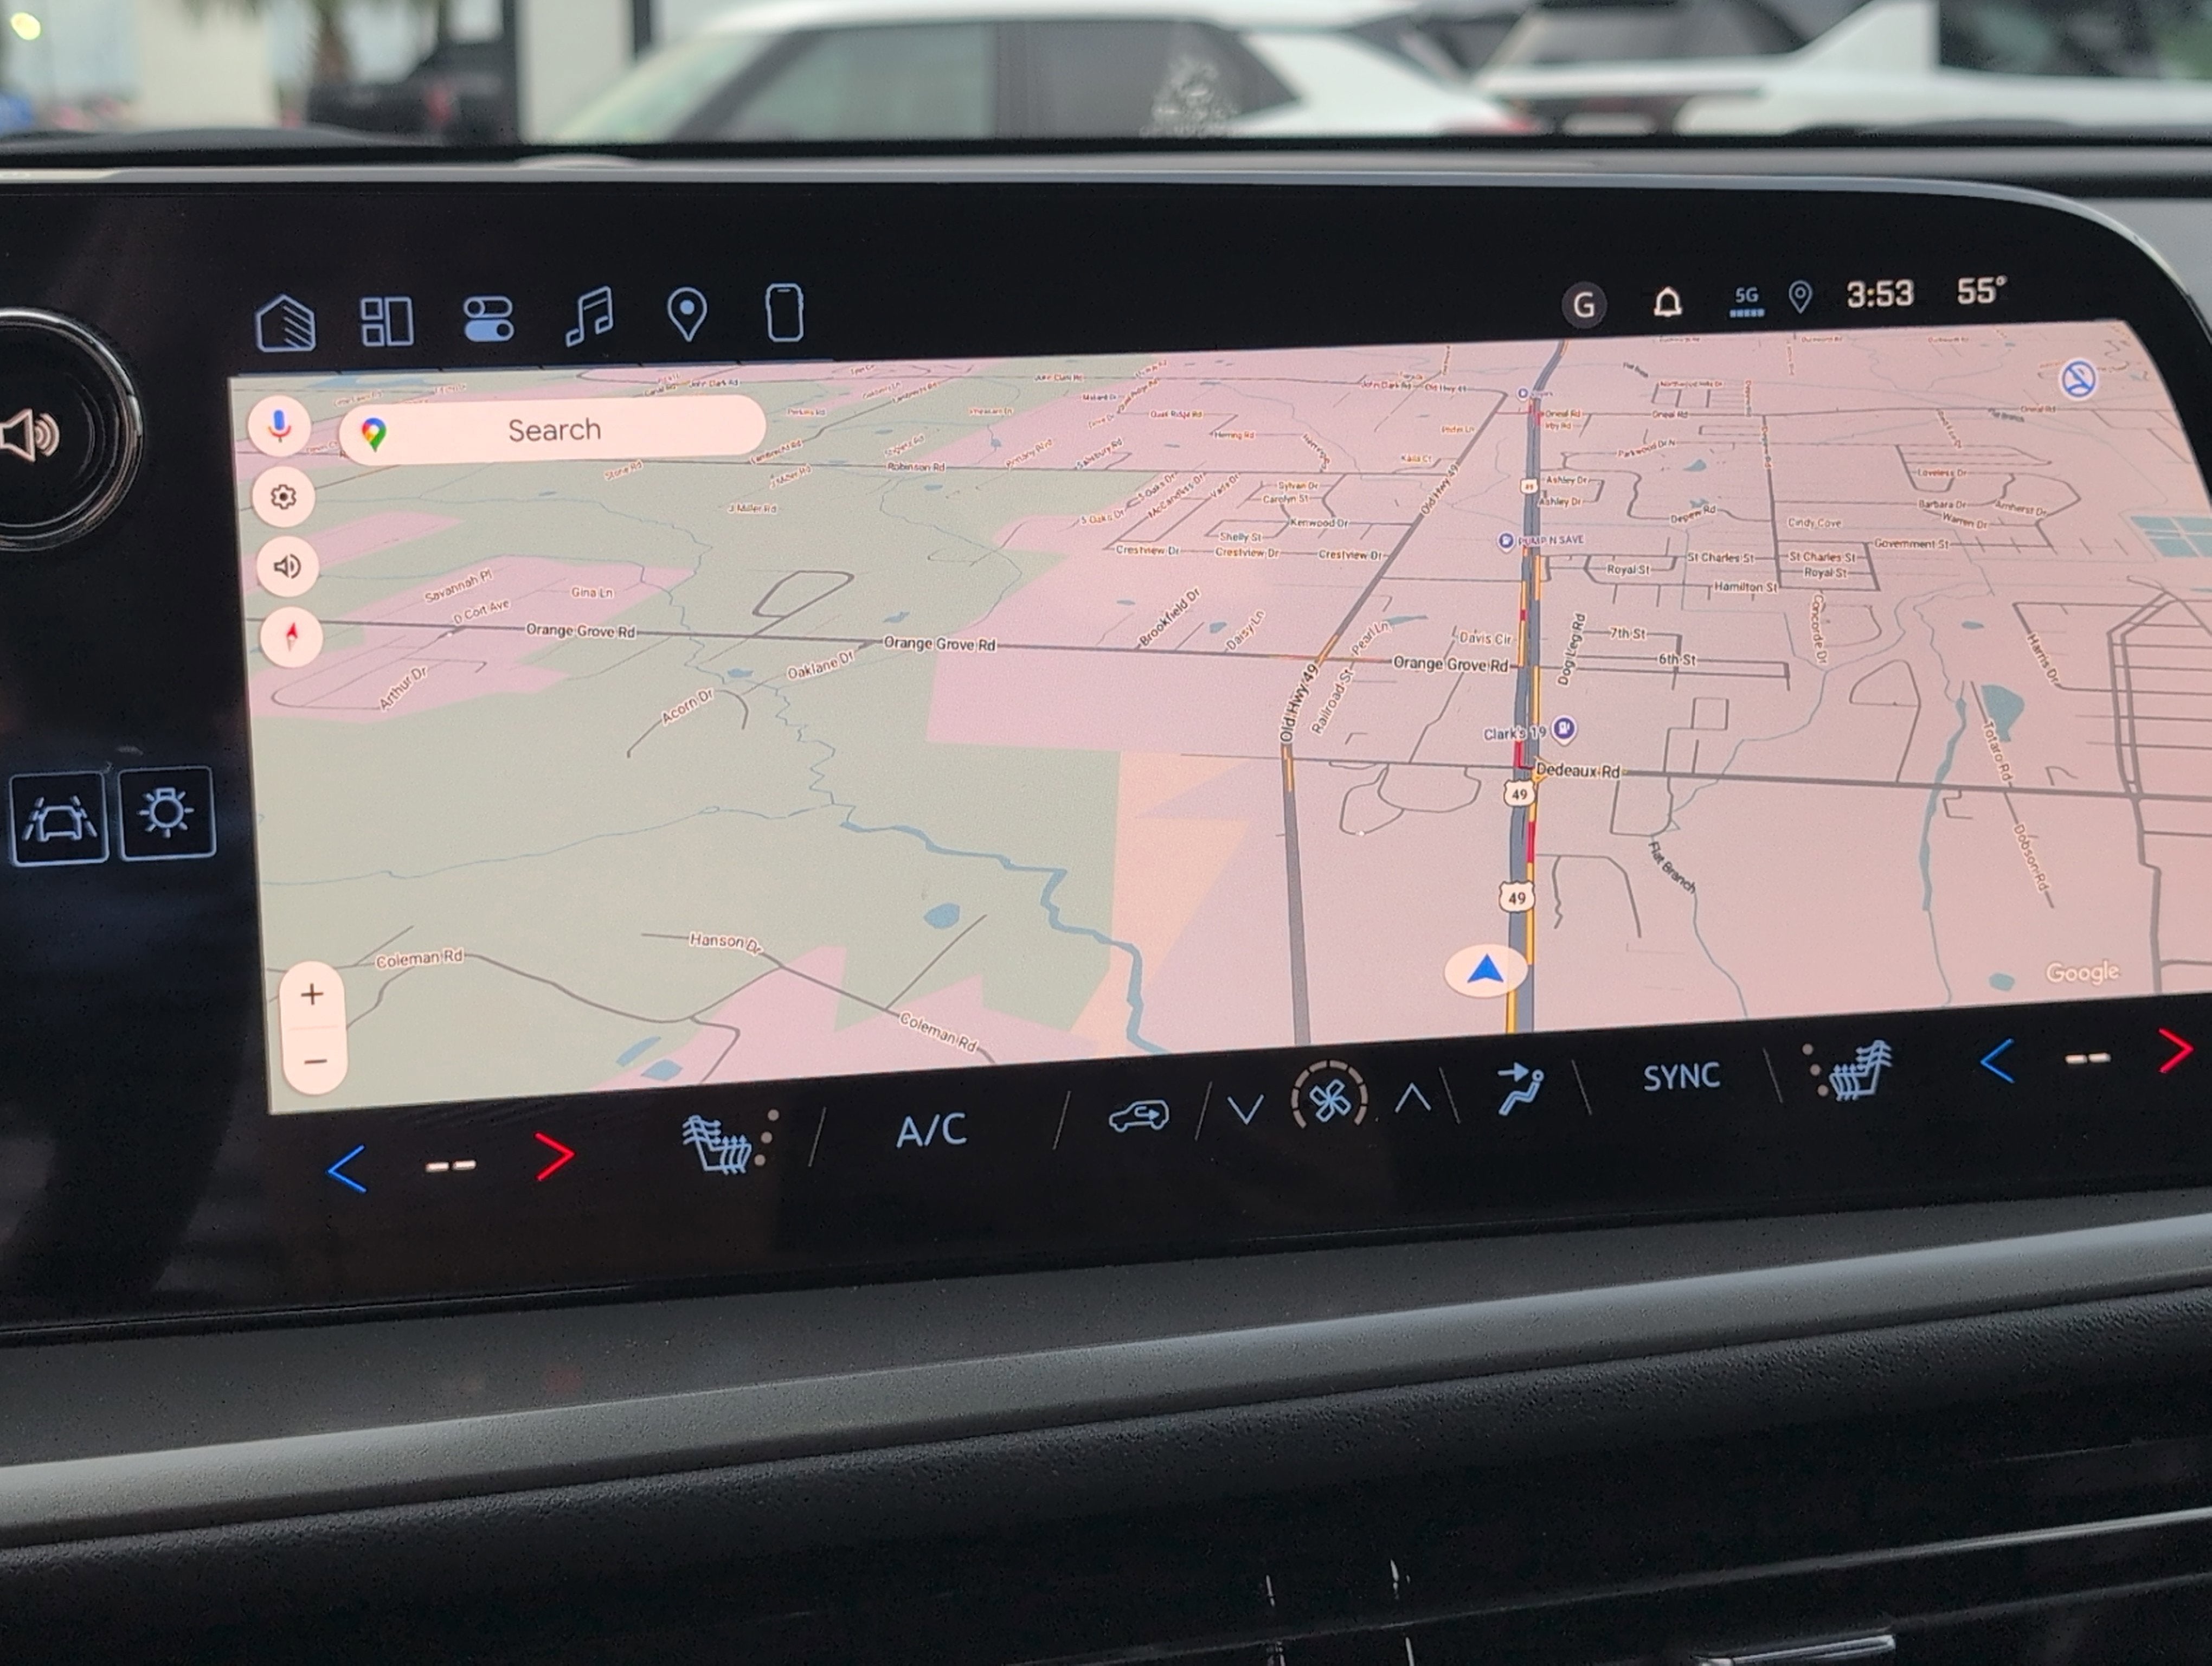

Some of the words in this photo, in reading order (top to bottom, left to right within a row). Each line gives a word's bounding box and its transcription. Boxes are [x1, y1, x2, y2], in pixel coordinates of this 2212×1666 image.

[1735, 287, 1759, 303] 5G
[1847, 279, 1914, 307] 3:53
[1958, 275, 2008, 304] 55°
[1574, 292, 1594, 318] G
[509, 418, 602, 441] Search
[888, 463, 930, 472] Robinson
[934, 463, 945, 472] Rd
[1165, 473, 1175, 484] Dr
[1278, 482, 1306, 490] Sylvan
[1546, 476, 1574, 485] Ashley
[1421, 497, 1436, 515] Old
[1433, 478, 1450, 498] Hwy
[1448, 464, 1458, 476] 49
[1539, 498, 1568, 508] Ashley
[1703, 505, 1715, 514] Rd
[1919, 500, 1953, 508] Barbara
[1995, 500, 2034, 514] Amherst
[2036, 507, 2047, 515] Dr
[1114, 510, 1124, 518] Dr
[1943, 512, 1974, 527] Warren
[1977, 520, 1988, 529] Dr
[1290, 518, 1334, 527] Kenwood
[1789, 518, 1814, 529] Cindy
[1818, 519, 1841, 528] Cove
[1220, 533, 1248, 543] Shelly
[1519, 536, 1547, 545] PUMP
[1559, 535, 1584, 543] SAVE
[1874, 539, 1934, 548] Government
[1938, 540, 1949, 549] St
[1116, 546, 1165, 554] Crestview
[1168, 547, 1178, 555] Dr
[1216, 548, 1263, 556] Crestview
[1268, 549, 1278, 558] Dr
[1319, 550, 1367, 559] Crestview
[1371, 552, 1381, 560] Dr
[1688, 552, 1698, 561] St
[1701, 552, 1739, 562] Charles
[1743, 554, 1754, 562] St
[1790, 552, 1800, 561] St
[1803, 552, 1841, 561] Charles
[1845, 553, 1855, 562] St
[1607, 565, 1636, 576] Royal
[1638, 565, 1649, 574] St
[1805, 567, 1833, 580] Royal
[1836, 568, 1847, 578] St
[425, 576, 478, 603] Savannah
[480, 569, 493, 584] Pl
[572, 588, 597, 597] Gina
[600, 587, 614, 598] Ln
[1714, 581, 1763, 591] Hamilton
[1766, 582, 1777, 592] St
[454, 614, 462, 624] D
[490, 600, 510, 613] Ave
[1139, 598, 1188, 646] Brookfield
[1186, 588, 1200, 602] Dr
[1812, 595, 1824, 648] Concorde
[526, 623, 573, 638] Orange
[577, 625, 615, 637] Grove
[618, 626, 636, 638] Rd
[1226, 624, 1254, 650] Daisy
[1251, 611, 1264, 625] Ln
[1460, 631, 1491, 644] Davis
[1495, 633, 1511, 644] Cir
[1610, 628, 1629, 639] 7th
[1633, 629, 1645, 639] St
[884, 636, 933, 650] Orange
[936, 638, 975, 650] Grove
[979, 639, 996, 651] Rd
[1352, 626, 1375, 655] Pearl
[1374, 623, 1388, 633] Ln
[1558, 659, 1572, 685] Dog
[1566, 634, 1579, 662] Leg
[1574, 614, 1585, 632] Rd
[1817, 649, 1827, 664] Dr
[788, 657, 838, 680] Oaklane
[839, 651, 854, 664] Dr
[1394, 655, 1443, 672] Orange
[1448, 658, 1487, 671] Grove
[1491, 658, 1508, 672] Rd
[1659, 654, 1677, 665] 6th
[1680, 655, 1696, 665] St
[2027, 634, 2049, 669] Harris
[2047, 669, 2060, 685] Dr
[1303, 664, 1319, 682] 49
[380, 676, 410, 710] Arthur
[410, 666, 427, 683] Dr
[661, 699, 698, 725] Acorn
[698, 688, 715, 704] Dr
[1286, 683, 1309, 714] Hwy
[1312, 683, 1345, 734] Railroad
[1340, 669, 1354, 683] St
[1280, 717, 1296, 742] Old
[1484, 727, 1526, 740] Clark's
[1532, 726, 1547, 738] 19
[1983, 721, 2003, 764] Totaro
[1998, 764, 2012, 781] Rd
[1537, 762, 1596, 777] Dedeaux
[1602, 765, 1619, 778] Rd
[1512, 790, 1527, 800] 49
[2014, 825, 2040, 872] Dobson
[2035, 874, 2048, 891] Rd
[1649, 842, 1663, 864] Flat
[1663, 862, 1696, 894] Branch
[1509, 893, 1526, 905] 49
[691, 934, 743, 950] Hanson
[745, 939, 761, 955] Dr
[376, 953, 441, 969] Coleman
[445, 949, 463, 963] Rd
[2046, 959, 2119, 986] Google
[900, 1013, 955, 1043] Coleman
[957, 1035, 978, 1053] Rd
[1644, 1061, 1720, 1091] SYNC
[897, 1112, 967, 1149] A/C
